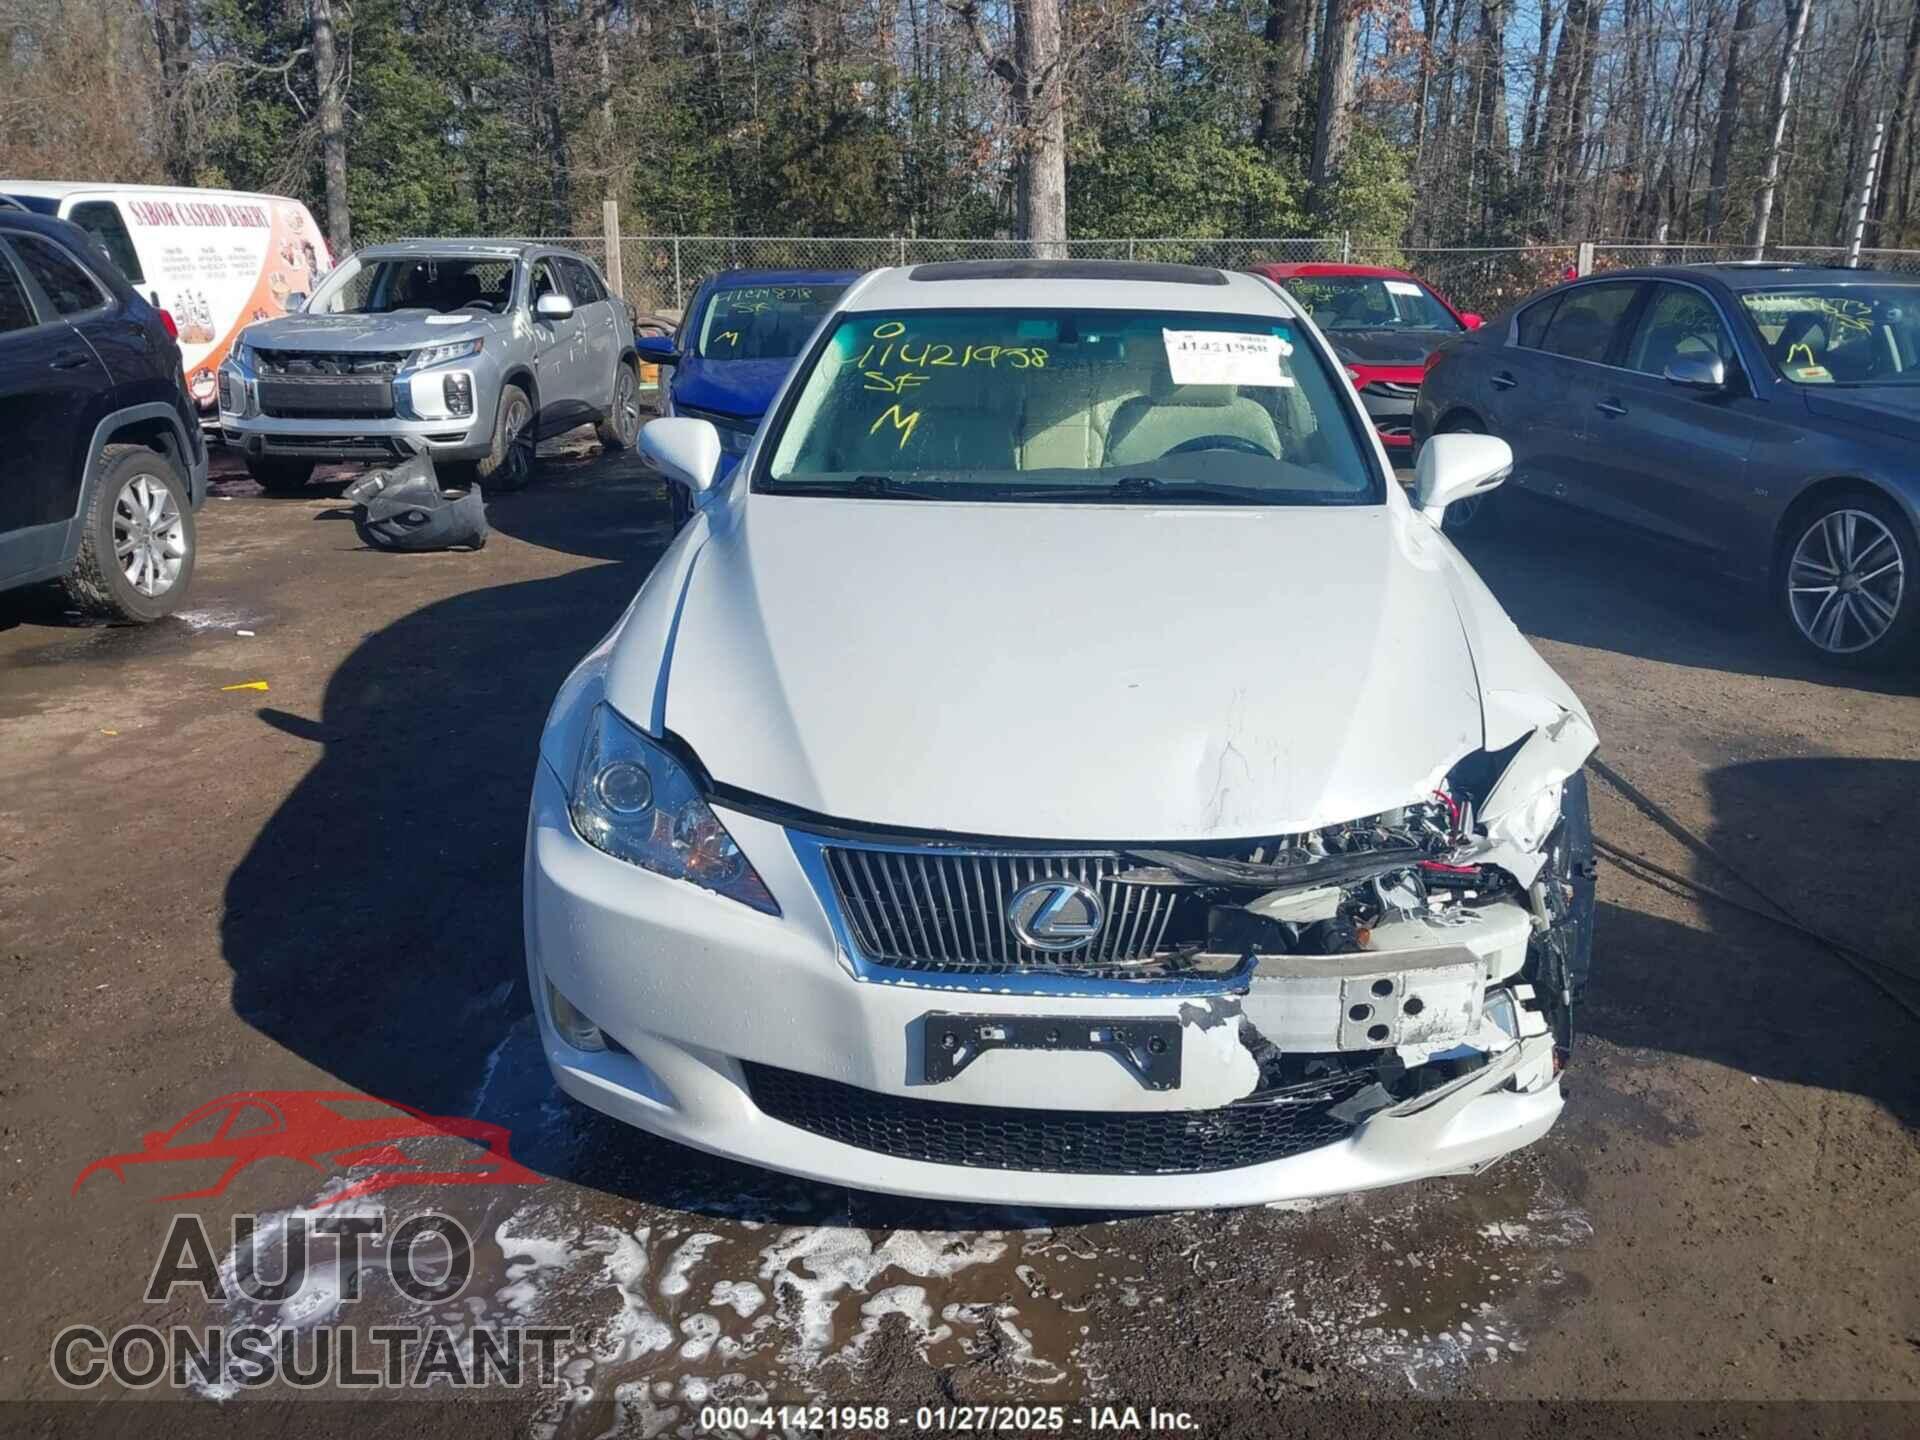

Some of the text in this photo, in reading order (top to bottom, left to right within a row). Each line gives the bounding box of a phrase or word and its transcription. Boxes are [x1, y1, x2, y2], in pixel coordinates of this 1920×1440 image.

[127, 200, 270, 229] SABOR CASERO BAKERY
[713, 330, 739, 347] M
[869, 404, 922, 450] M
